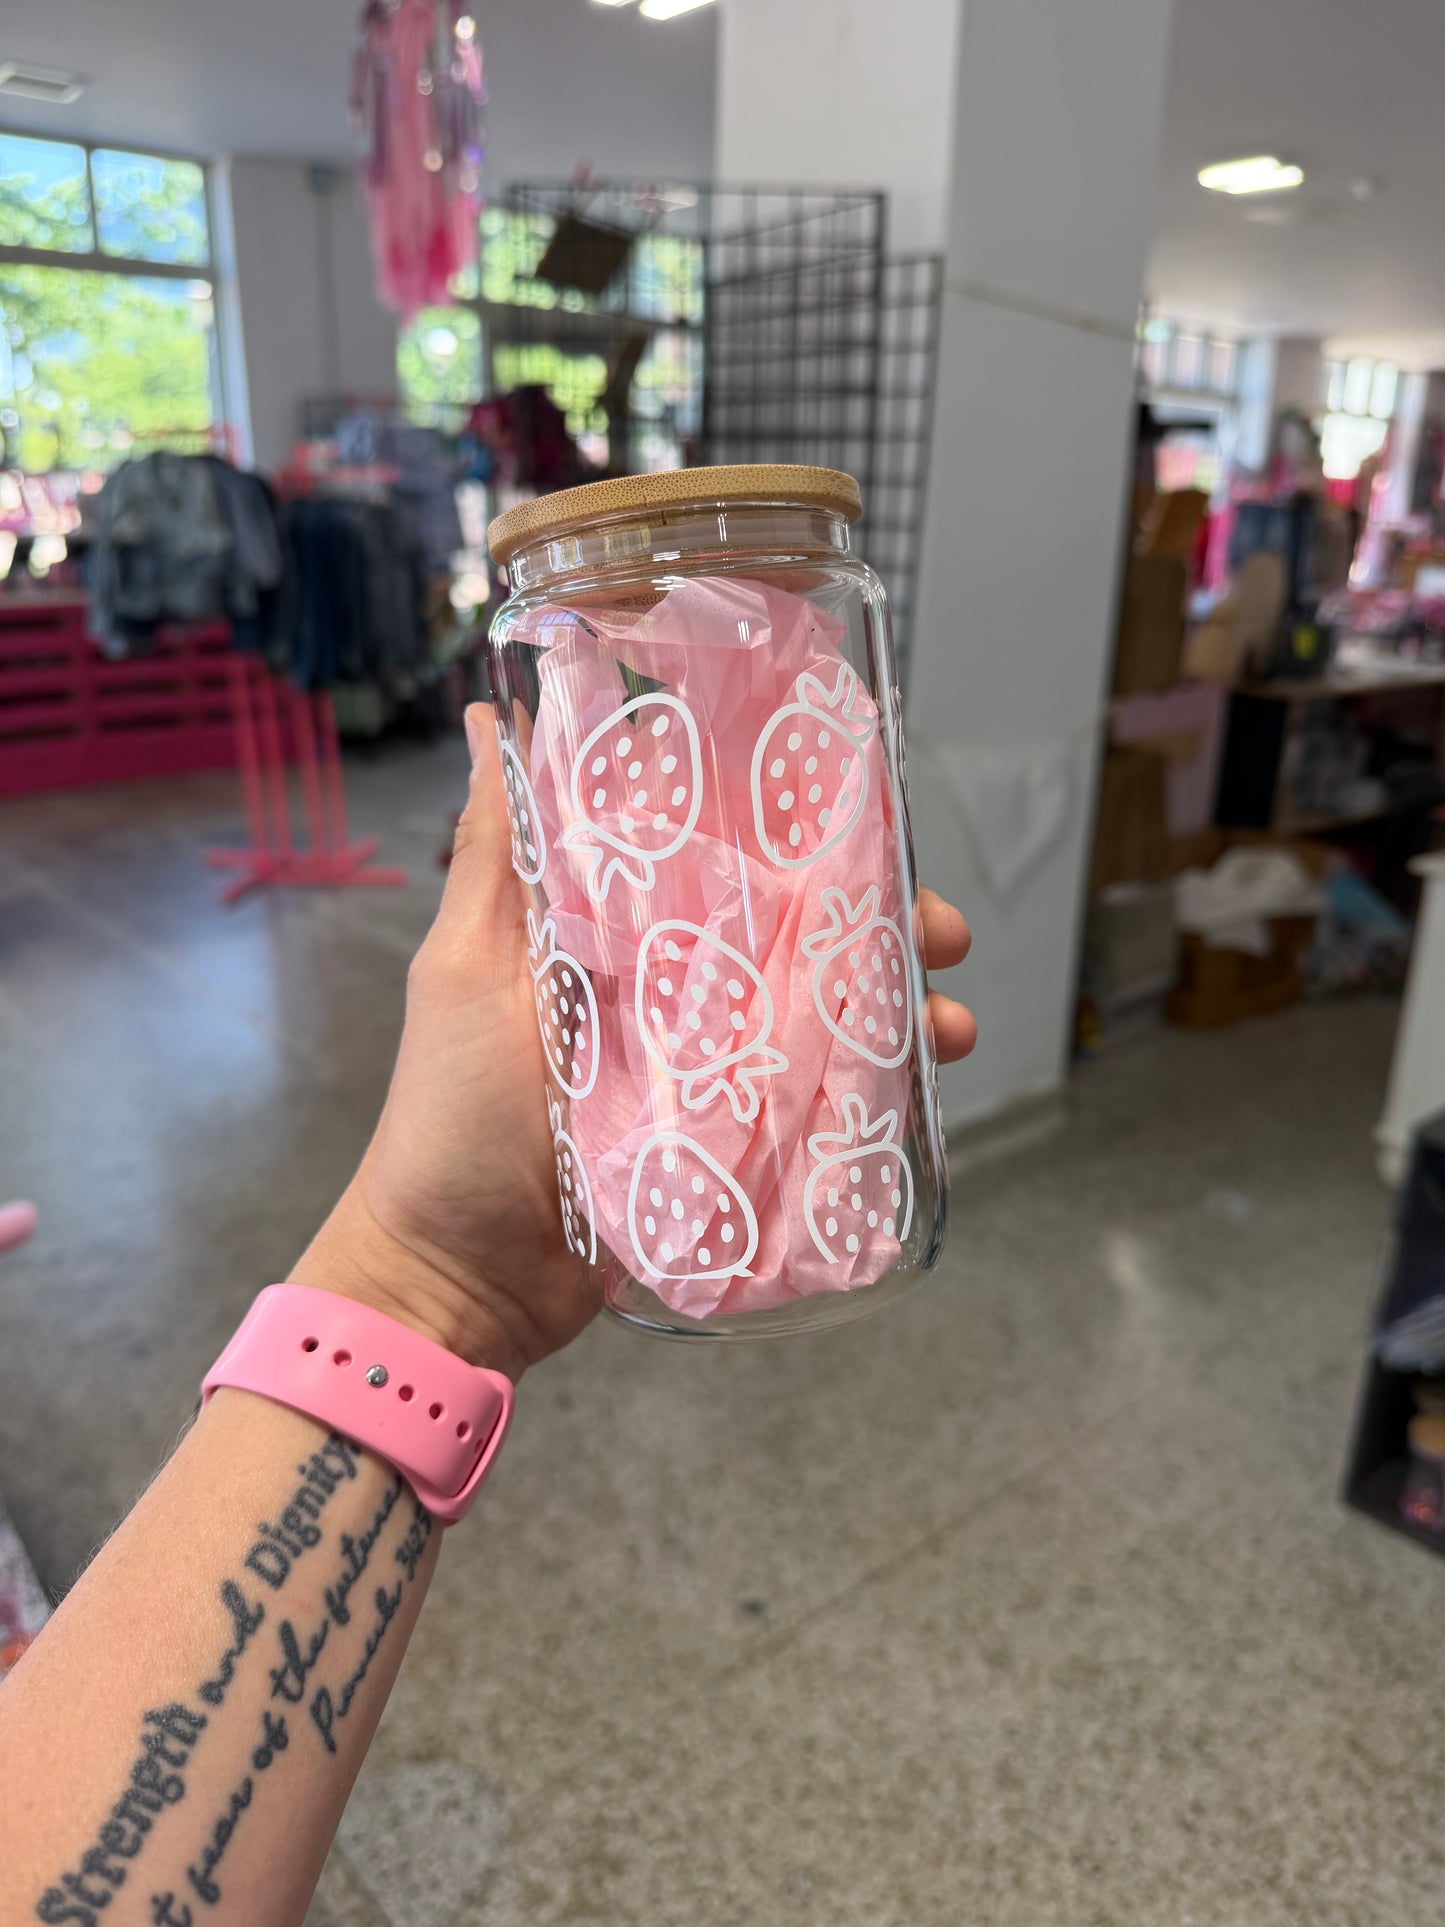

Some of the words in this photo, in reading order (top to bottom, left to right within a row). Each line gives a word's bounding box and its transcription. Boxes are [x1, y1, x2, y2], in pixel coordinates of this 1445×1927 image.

[269, 1619, 329, 1704] the
[37, 1702, 207, 1927] Strength
[199, 1579, 265, 1706] and
[253, 1711, 290, 1771] of
[187, 1778, 254, 1905] fear
